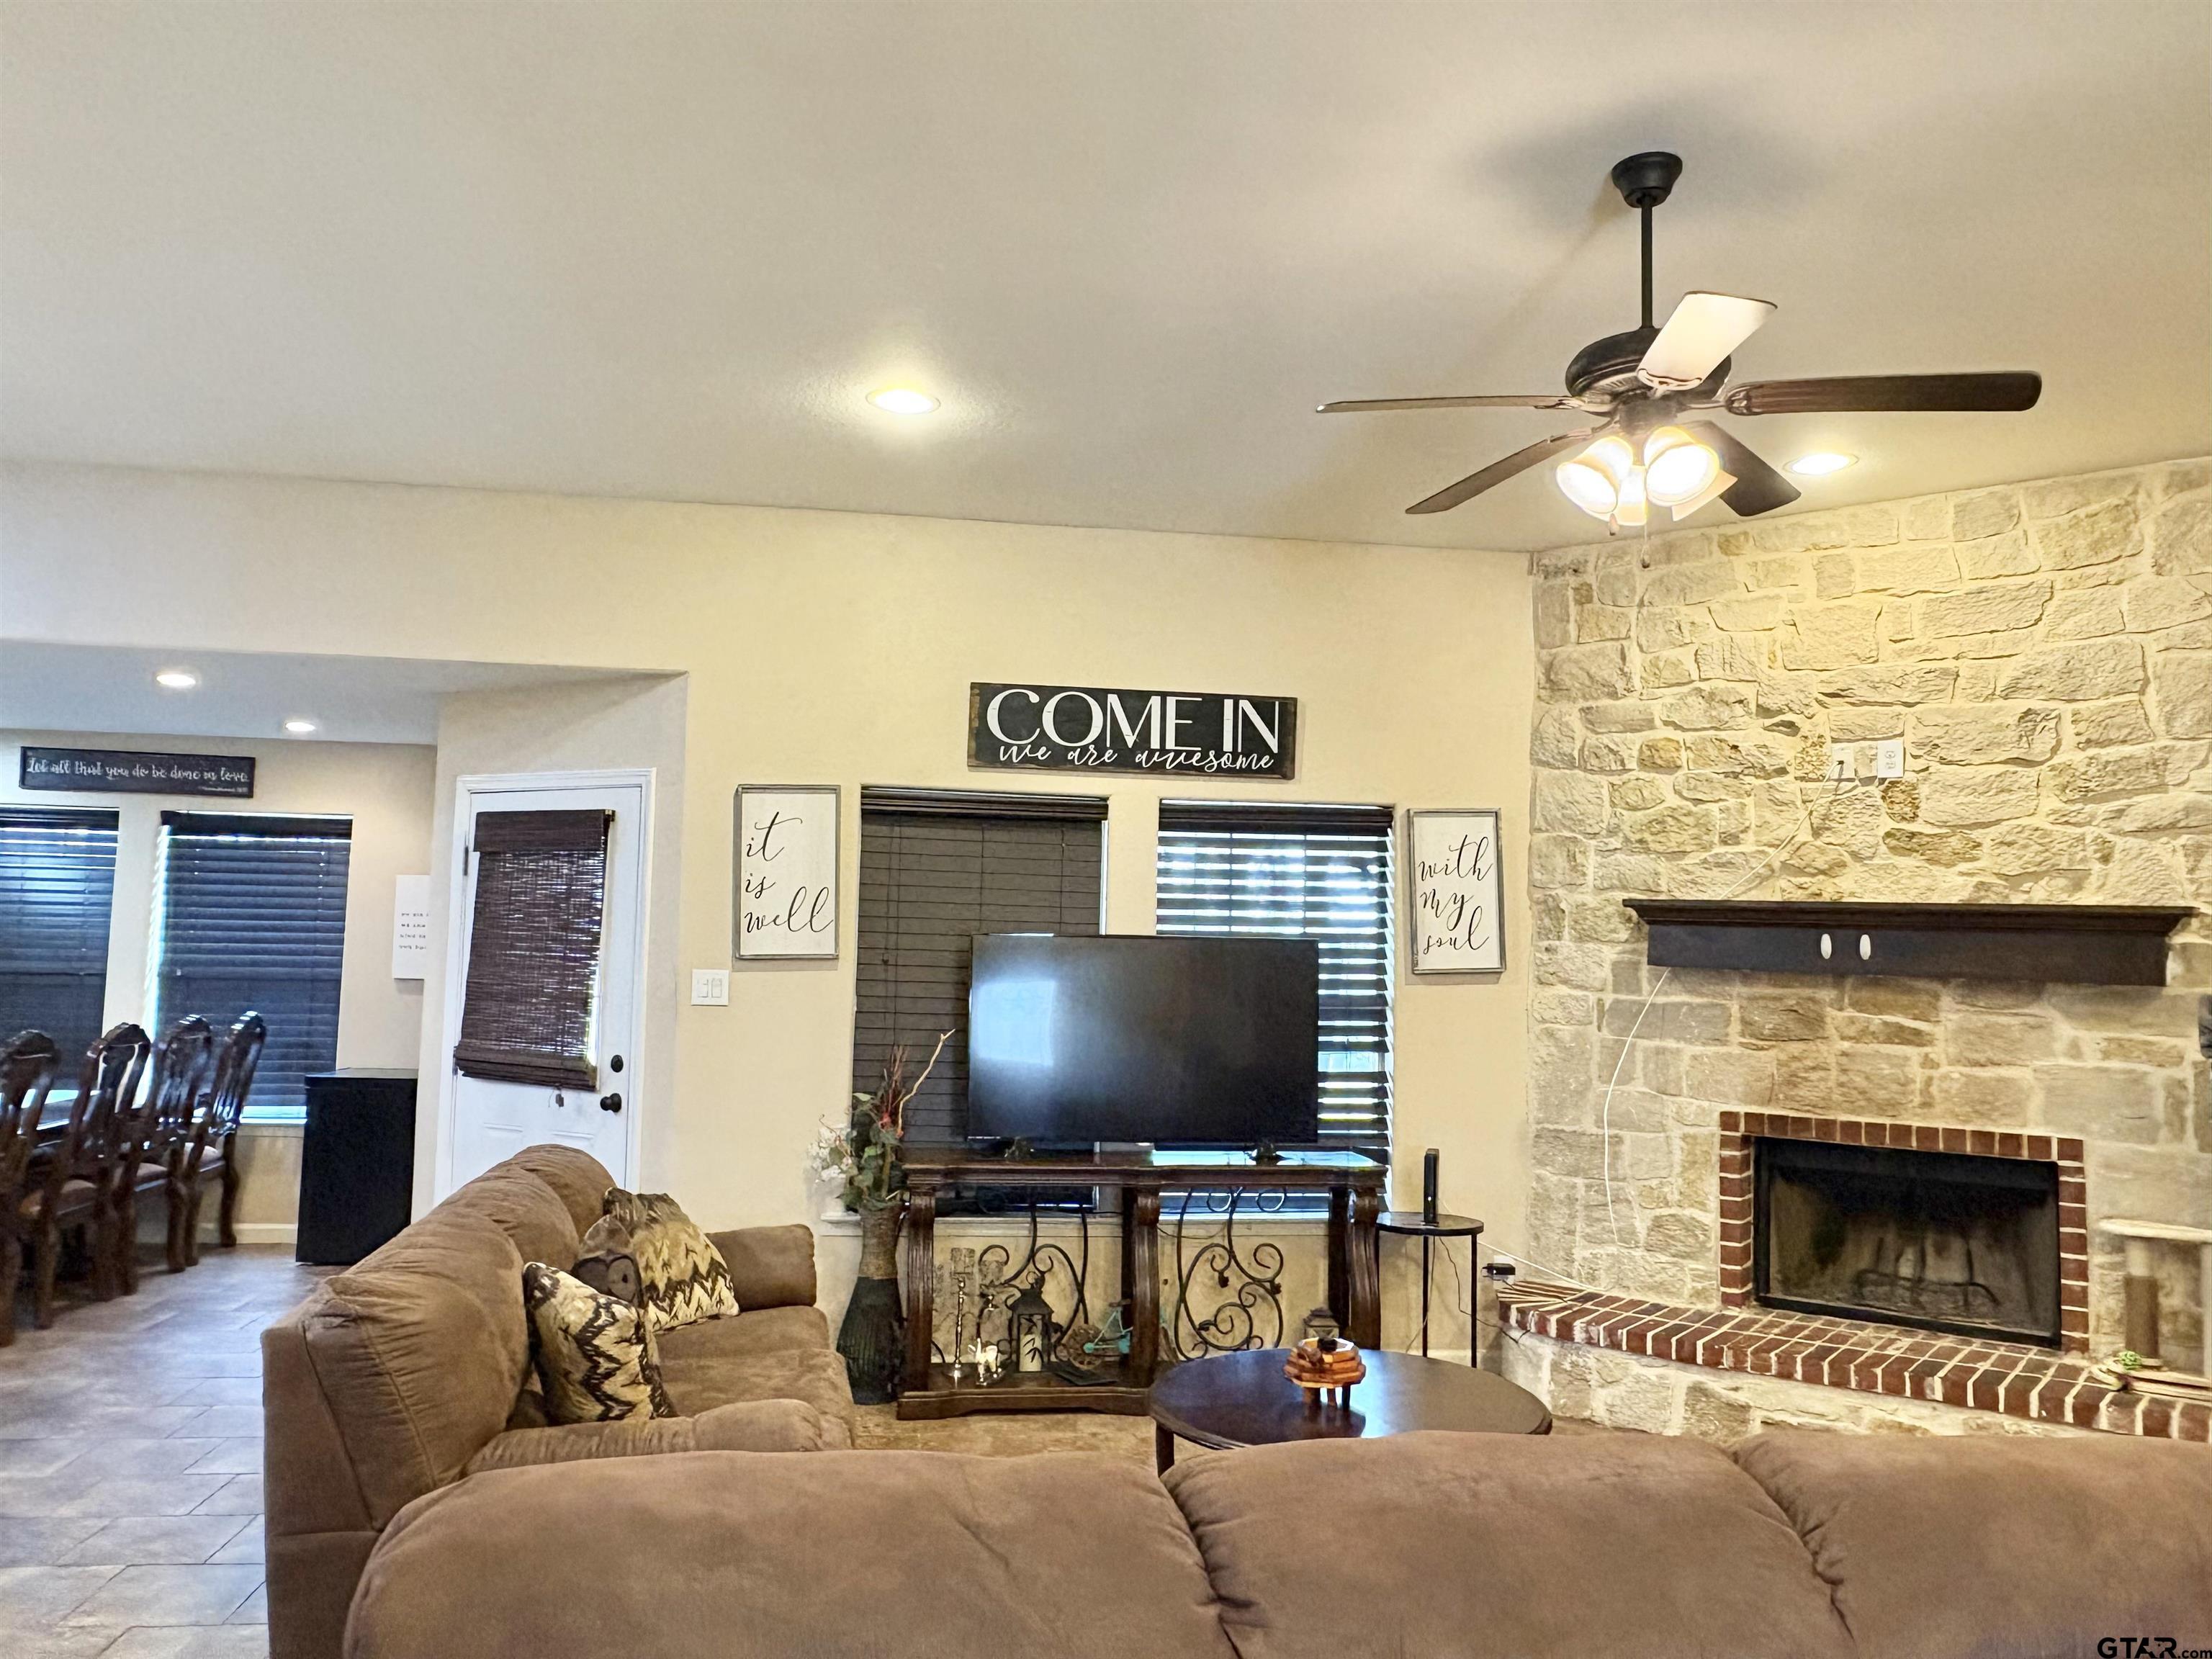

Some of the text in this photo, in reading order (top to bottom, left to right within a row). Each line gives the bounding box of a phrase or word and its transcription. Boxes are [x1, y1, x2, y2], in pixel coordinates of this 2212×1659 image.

[986, 688, 1279, 753] COME IN
[50, 760, 71, 774] all
[75, 761, 102, 775] that
[105, 765, 130, 780] you
[132, 764, 149, 778] do
[151, 764, 167, 778] be
[170, 765, 201, 779] done
[220, 768, 249, 782] love
[999, 743, 1274, 773] we are awesome
[746, 811, 803, 861] it
[1418, 835, 1493, 881] with
[744, 886, 834, 932] well
[745, 873, 776, 899] is
[1420, 889, 1475, 931] my
[1423, 906, 1490, 954] soul
